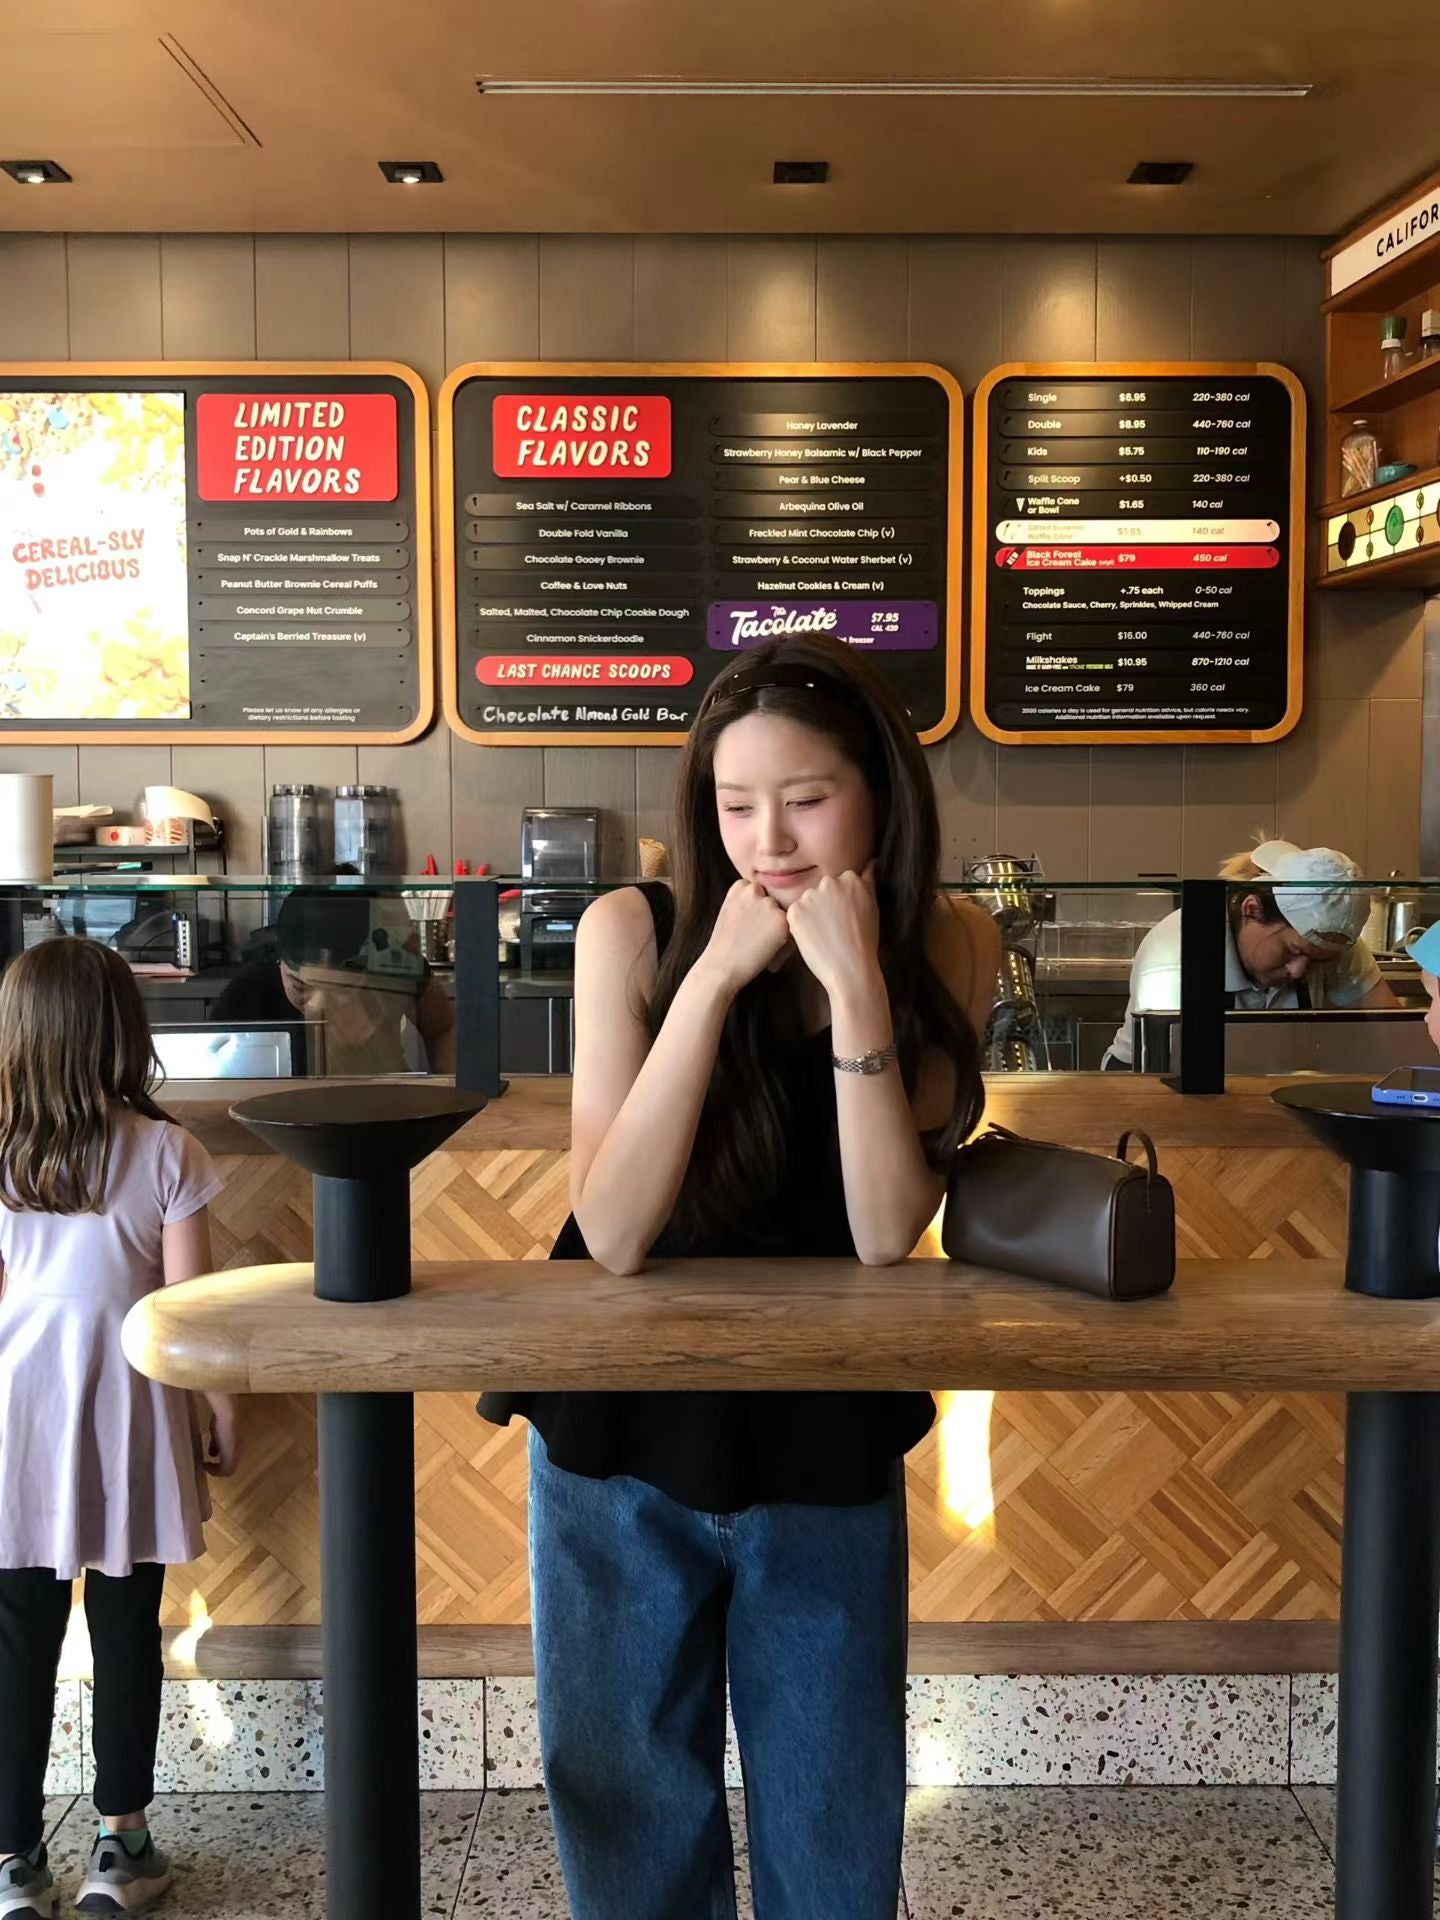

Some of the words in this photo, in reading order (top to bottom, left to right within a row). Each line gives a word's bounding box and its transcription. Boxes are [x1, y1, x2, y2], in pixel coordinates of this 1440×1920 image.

[1377, 203, 1439, 256] CALIFOR
[1028, 392, 1057, 404] Single
[1192, 392, 1233, 402] 220-380
[1235, 392, 1250, 402] cal
[234, 402, 345, 428] LIMITED
[516, 405, 639, 433] CLASSIC
[786, 421, 815, 432] Honey
[817, 421, 858, 430] Lavender
[1028, 420, 1062, 430] Double
[1192, 420, 1234, 429] 440-760
[1237, 420, 1251, 429] cal
[235, 436, 344, 461] EDITION
[517, 439, 651, 467] FLAVORS
[724, 448, 772, 459] Strawberry
[774, 449, 803, 459] Honey
[805, 448, 846, 457] Balsamic
[848, 447, 860, 458] w/
[862, 448, 887, 457] Black
[888, 449, 922, 459] Pepper
[1028, 447, 1048, 456] Kids
[1197, 446, 1230, 456] 110-190
[1232, 446, 1247, 456] cal
[233, 468, 361, 495] FLAVORS
[779, 475, 799, 484] Pear
[801, 475, 808, 484] &
[810, 475, 829, 484] Blue
[831, 475, 865, 484] Cheese
[1028, 474, 1049, 486] Split
[1051, 474, 1080, 486] Scoop
[1119, 473, 1152, 484] +$0.50
[1193, 474, 1233, 483] 220-380
[1235, 474, 1250, 483] cal
[516, 502, 535, 511] Sea
[536, 502, 554, 511] Salt
[556, 500, 569, 511] w/
[571, 502, 612, 511] Caramel
[614, 502, 652, 511] Ribbons
[779, 502, 826, 513] Arbequina
[827, 502, 850, 511] Olive
[852, 502, 863, 511] Oil
[1028, 497, 1055, 506] Waffle
[1057, 497, 1080, 506] Cone
[1119, 500, 1144, 510] $1.65
[1038, 506, 1059, 514] Bowl
[244, 527, 264, 536] Pots
[267, 527, 275, 536] of
[278, 527, 299, 536] Gold
[300, 527, 307, 536] &
[309, 527, 352, 536] Rainbows
[539, 529, 572, 538] Double
[574, 529, 594, 538] Fold
[596, 529, 628, 538] Vanilla
[749, 529, 786, 538] Freckled
[788, 529, 807, 538] Mint
[809, 529, 855, 538] Chocolate
[857, 529, 879, 540] Chip
[881, 527, 895, 539] (v)
[12, 528, 145, 564] CEREAL-SLY
[217, 554, 241, 563] Snap
[254, 554, 288, 562] Crackle
[290, 554, 350, 562] Marshmallow
[351, 554, 380, 562] Treats
[732, 555, 781, 566] Strawberry
[783, 556, 790, 565] &
[791, 556, 829, 565] Coconut
[831, 556, 858, 565] Water
[860, 555, 896, 565] Sherbet
[898, 554, 912, 565] (v)
[1026, 550, 1052, 559] Black
[1054, 550, 1082, 559] Forest
[1026, 559, 1040, 567] Ice
[1042, 559, 1070, 567] Cream
[1072, 559, 1097, 567] Cake
[1118, 553, 1136, 564] $79
[1193, 553, 1210, 562] 450
[1212, 553, 1228, 562] cal
[524, 555, 574, 564] Chocolate
[575, 555, 605, 566] Gooey
[607, 555, 645, 564] Brownie
[25, 558, 140, 590] DELICIOUS
[221, 580, 253, 588] Peanut
[255, 580, 282, 588] Butter
[285, 580, 321, 588] Brownie
[323, 580, 351, 588] Cereal
[354, 580, 378, 588] Puffs
[540, 581, 572, 590] Coffee
[574, 581, 581, 590] &
[583, 581, 604, 590] Love
[606, 581, 627, 590] Nuts
[757, 581, 796, 591] Hazelnut
[798, 581, 831, 591] Cookies
[833, 581, 840, 591] &
[841, 581, 870, 591] Cream
[872, 580, 884, 592] (v)
[1023, 586, 1065, 597] Toppings
[1120, 586, 1140, 594] +.75
[1142, 586, 1164, 594] each
[1195, 586, 1218, 594] 0-50
[1219, 586, 1232, 594] cal
[1022, 601, 1061, 609] Chocolate
[1063, 601, 1089, 610] Sauce,
[1090, 601, 1118, 610] Cherry,
[1119, 601, 1157, 610] Sprinkles,
[1158, 600, 1192, 610] Whipped
[1194, 600, 1218, 608] Cream
[236, 606, 275, 615] Concord
[277, 607, 304, 616] Grape
[306, 607, 323, 615] Nut
[324, 606, 363, 615] Crumble
[480, 608, 512, 618] Salted,
[514, 608, 549, 618] Malted,
[550, 608, 599, 617] Chocolate
[601, 608, 622, 619] Chip
[624, 608, 656, 617] Cookie
[658, 608, 690, 619] Dough
[871, 612, 899, 623] $7.95
[730, 607, 838, 645] Tacolate
[234, 632, 275, 642] Captain's
[278, 632, 310, 641] Berried
[312, 632, 351, 641] Treasure
[354, 632, 366, 641] (v)
[526, 634, 576, 643] Cinnamon
[578, 634, 644, 643] Snickerdoodle
[1026, 631, 1052, 643] Flight
[1118, 631, 1147, 641] $16.00
[1192, 631, 1233, 640] 440-760
[1235, 631, 1250, 640] cal
[1026, 656, 1078, 664] Milkshakes
[1118, 658, 1147, 667] $10.95
[1192, 658, 1233, 666] 870-1210
[1235, 658, 1250, 666] cal
[497, 663, 538, 679] LAST
[541, 663, 601, 679] CHANCE
[609, 663, 671, 679] SCOOPS
[1025, 684, 1038, 692] Ice
[1041, 684, 1074, 692] Cream
[1076, 684, 1100, 692] Cake
[1116, 683, 1134, 693] $79
[483, 706, 569, 724] Chocolate
[575, 708, 618, 722] Almond
[622, 708, 650, 721] Gold
[657, 707, 688, 722] Bar
